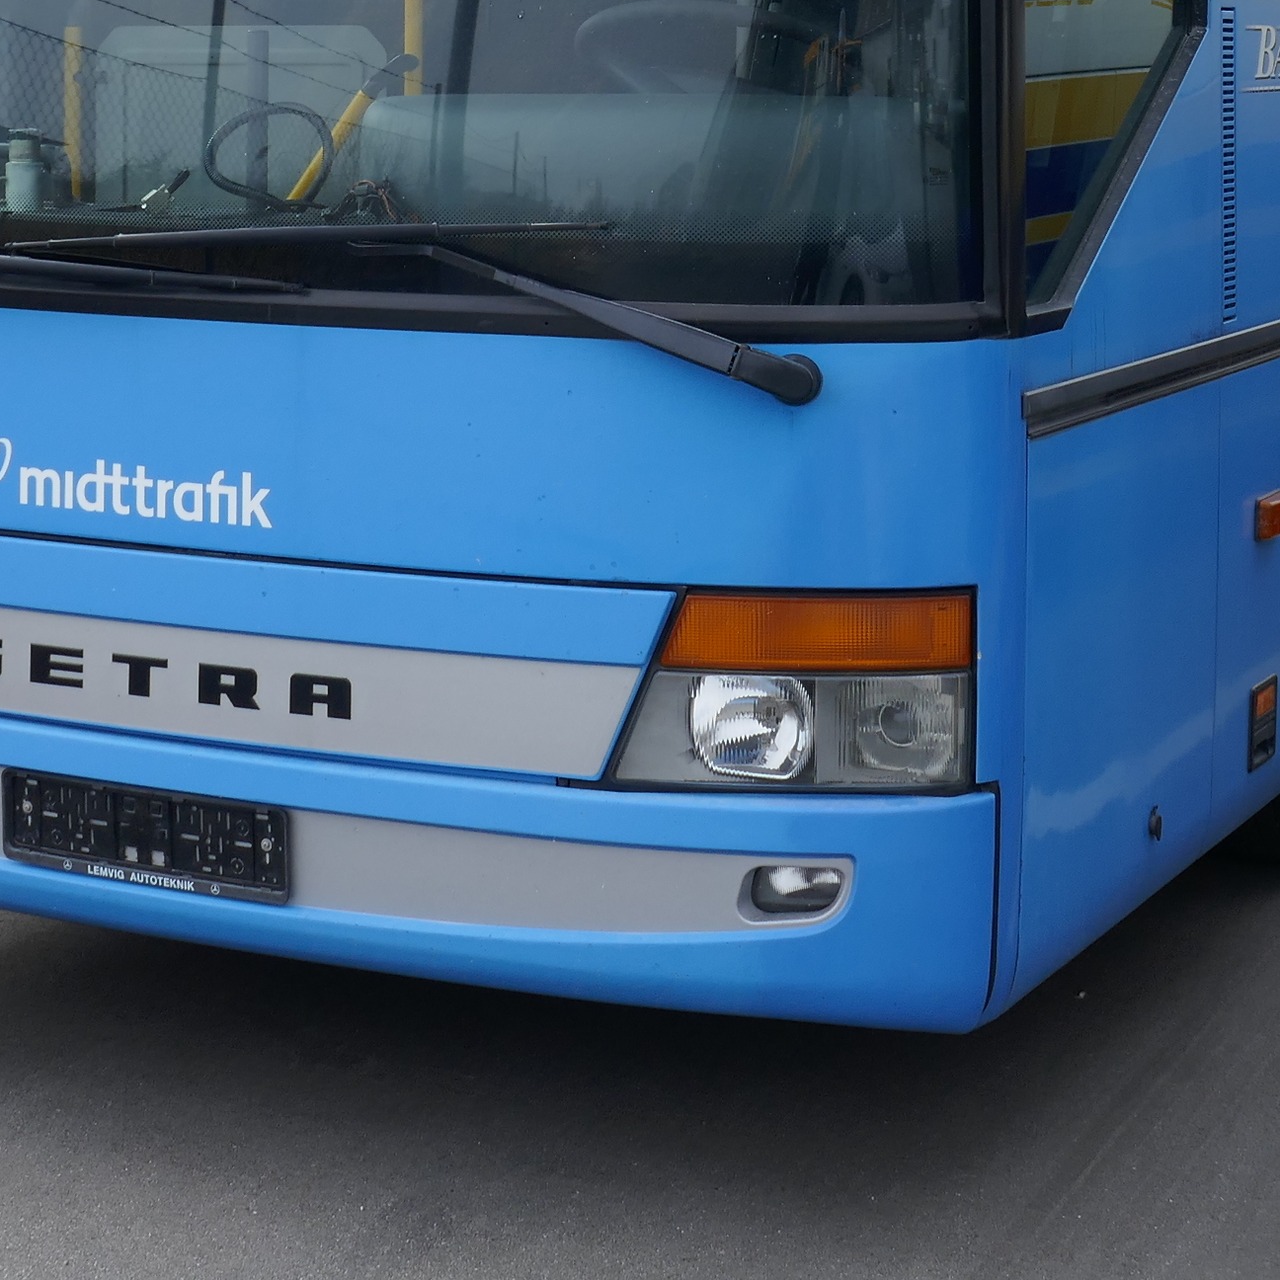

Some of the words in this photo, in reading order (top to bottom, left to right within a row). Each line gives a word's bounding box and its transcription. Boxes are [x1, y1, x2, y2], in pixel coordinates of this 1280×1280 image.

[19, 458, 272, 528] midttrafik
[87, 864, 125, 880] LEMVIG
[129, 872, 195, 892] AUTOTEKNIK
